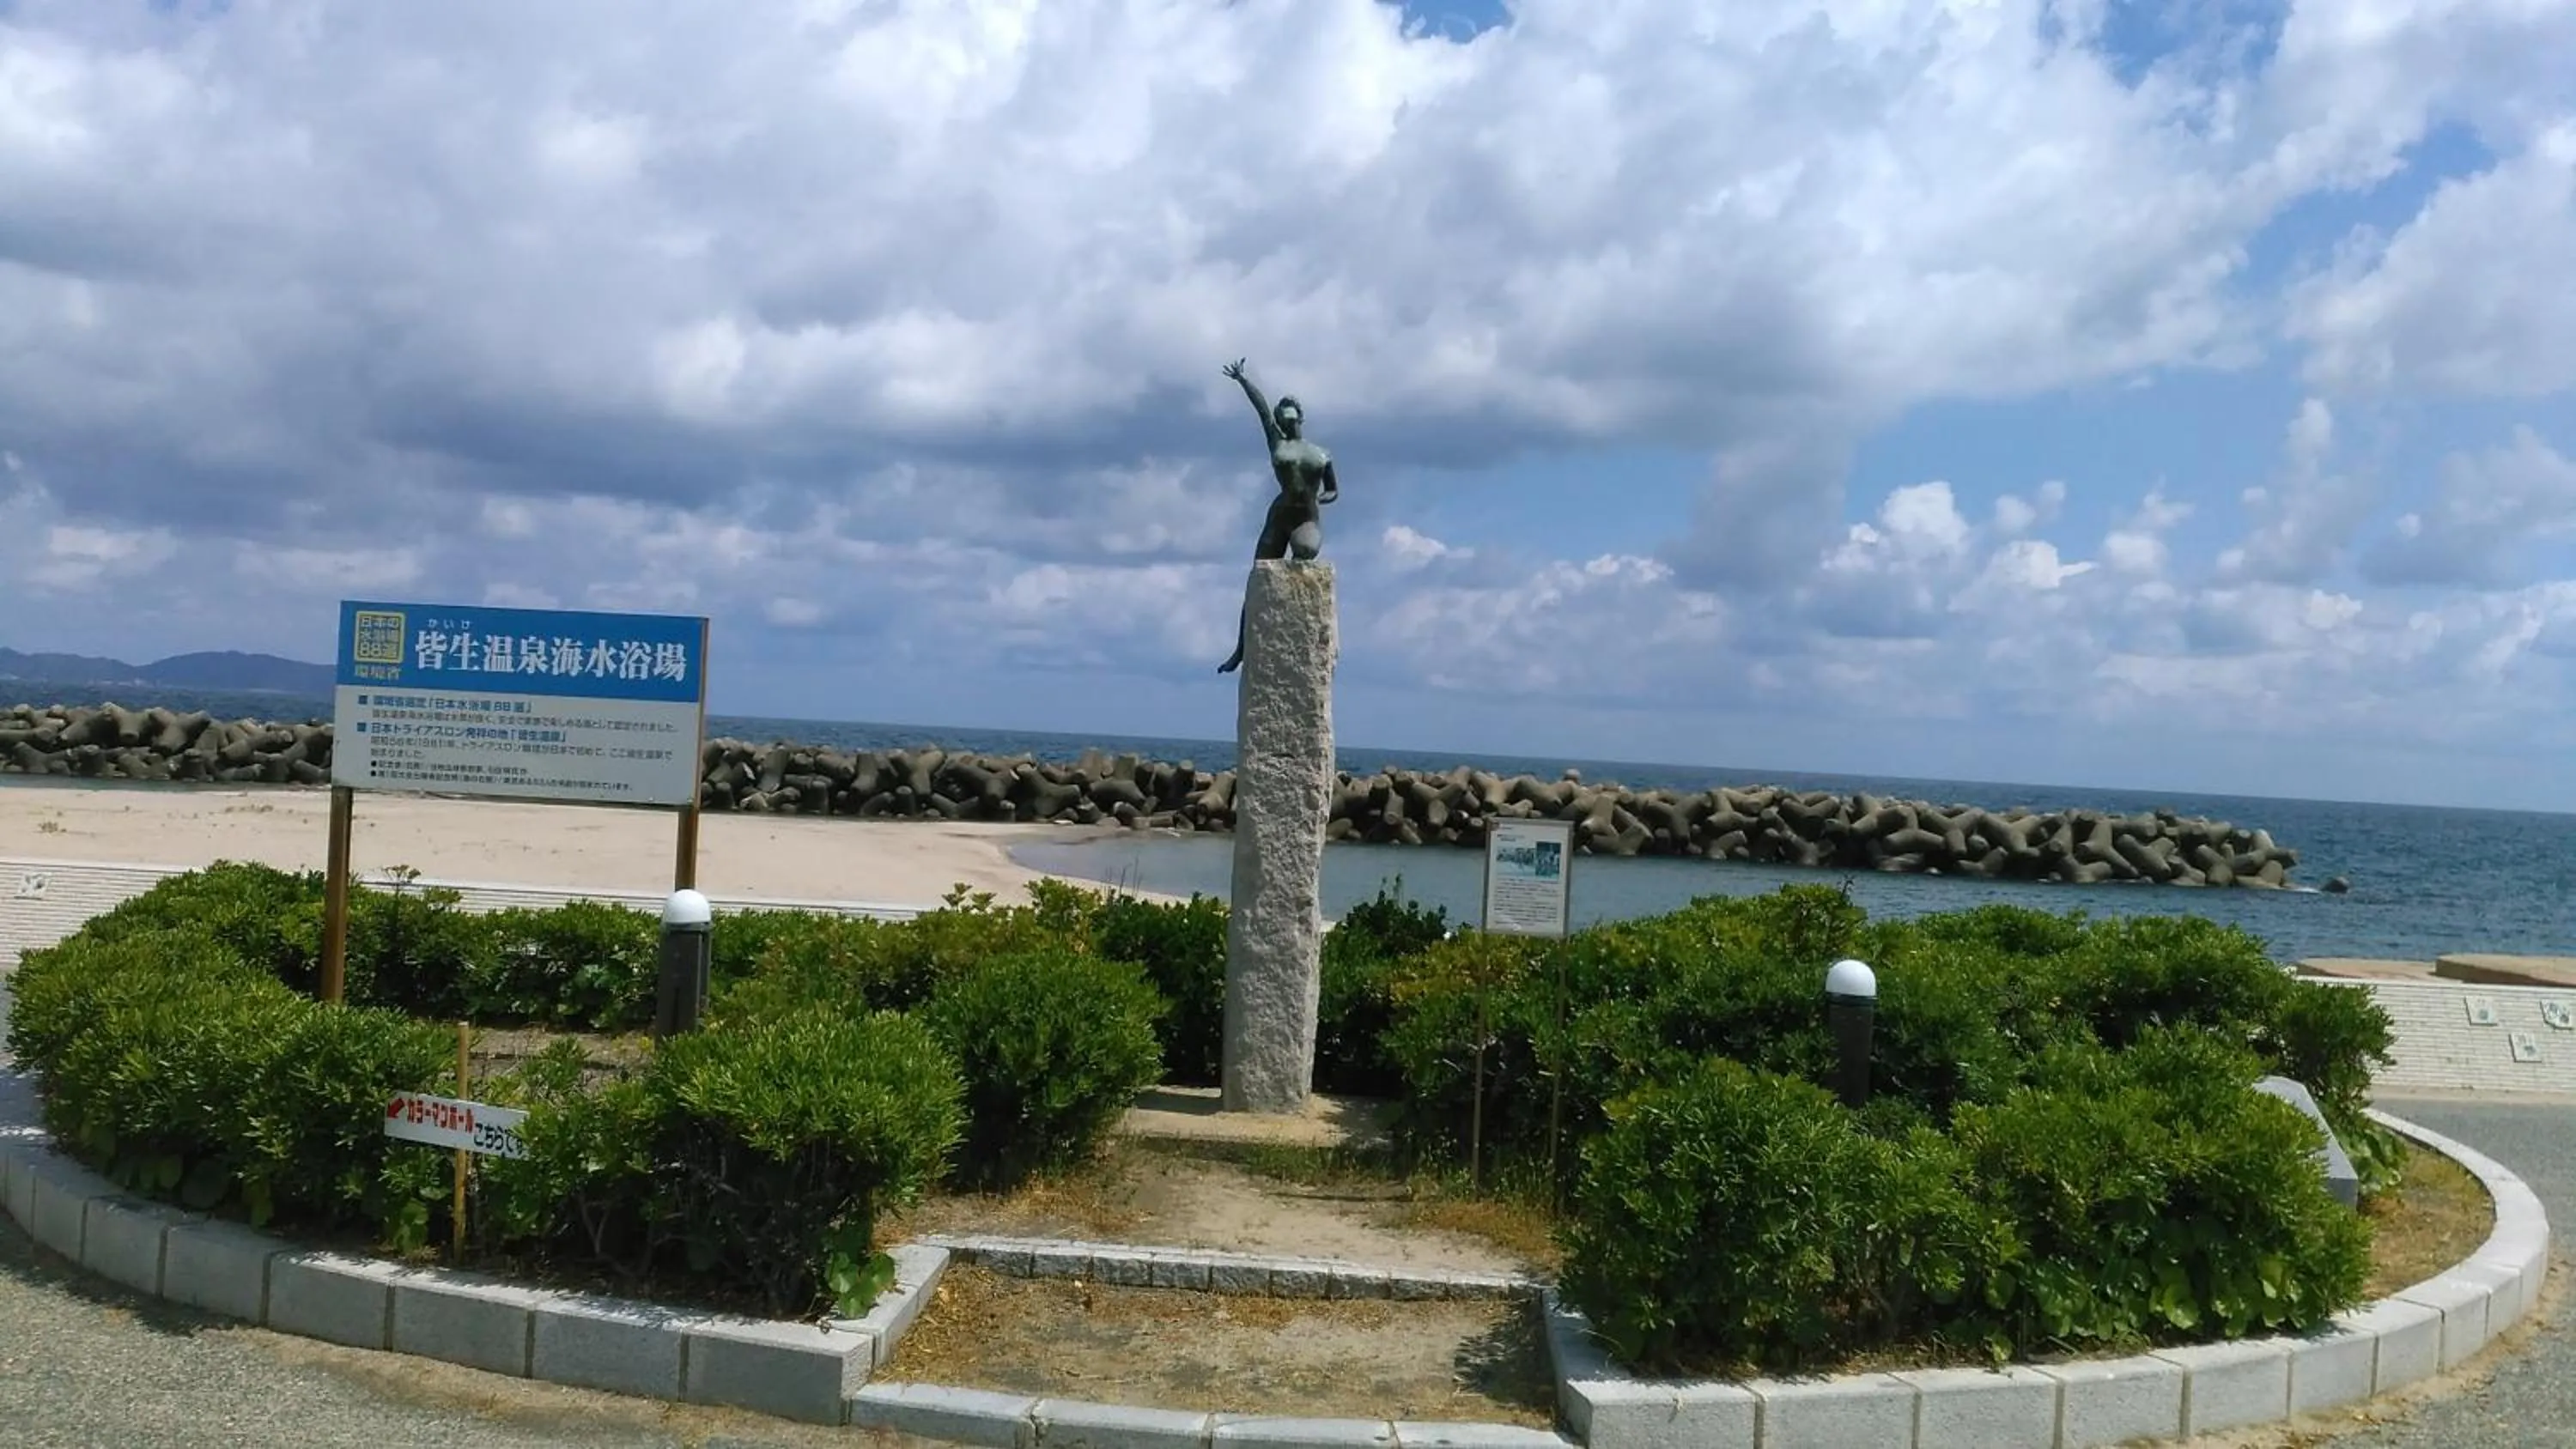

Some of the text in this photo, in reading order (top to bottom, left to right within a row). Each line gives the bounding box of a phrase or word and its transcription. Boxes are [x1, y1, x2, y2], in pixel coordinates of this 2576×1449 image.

[428, 618, 471, 629] かいけ
[415, 629, 687, 682] 皆生温泉海水浴場
